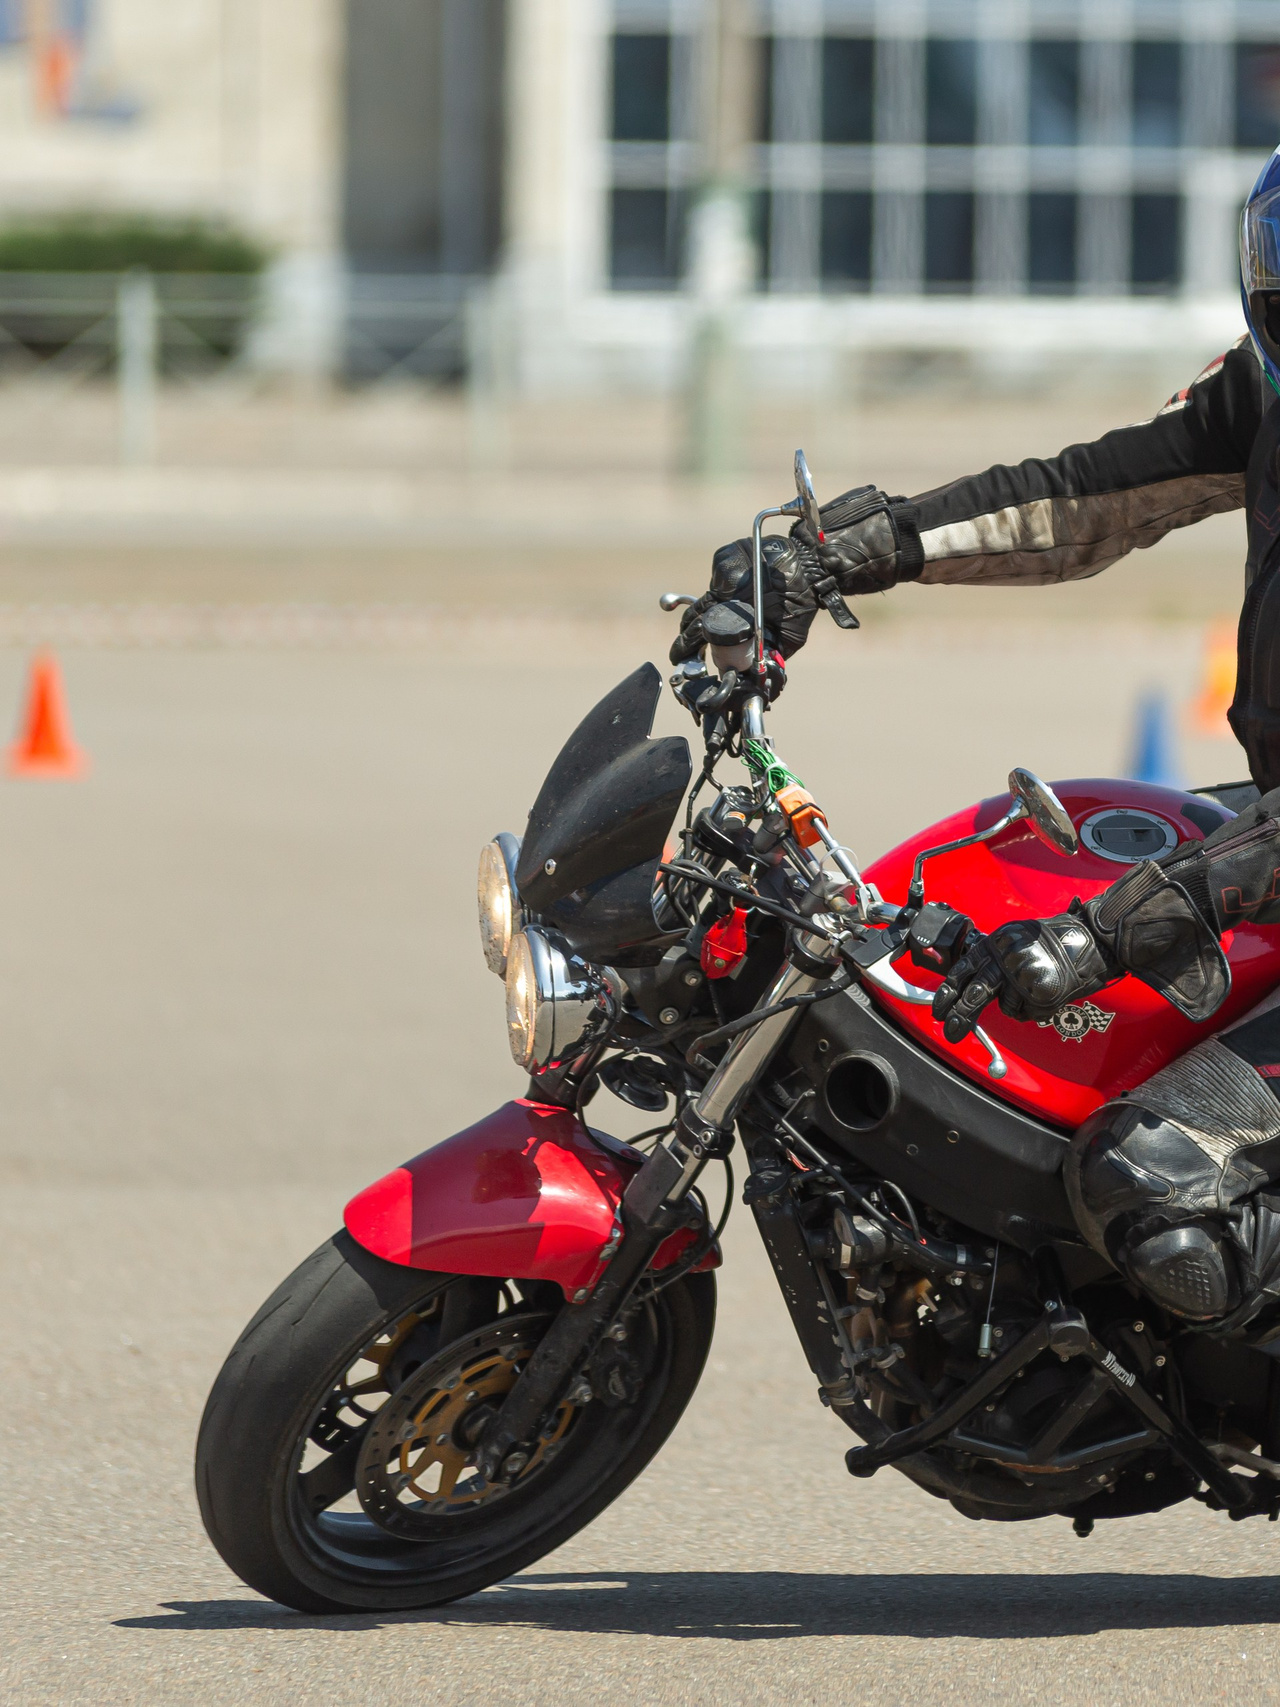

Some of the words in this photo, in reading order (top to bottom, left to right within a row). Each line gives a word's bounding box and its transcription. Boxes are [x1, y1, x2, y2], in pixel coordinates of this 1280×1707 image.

[1055, 1006, 1069, 1018] ACE
[1070, 1006, 1088, 1020] CAFE
[1056, 1024, 1087, 1037] LONDON
